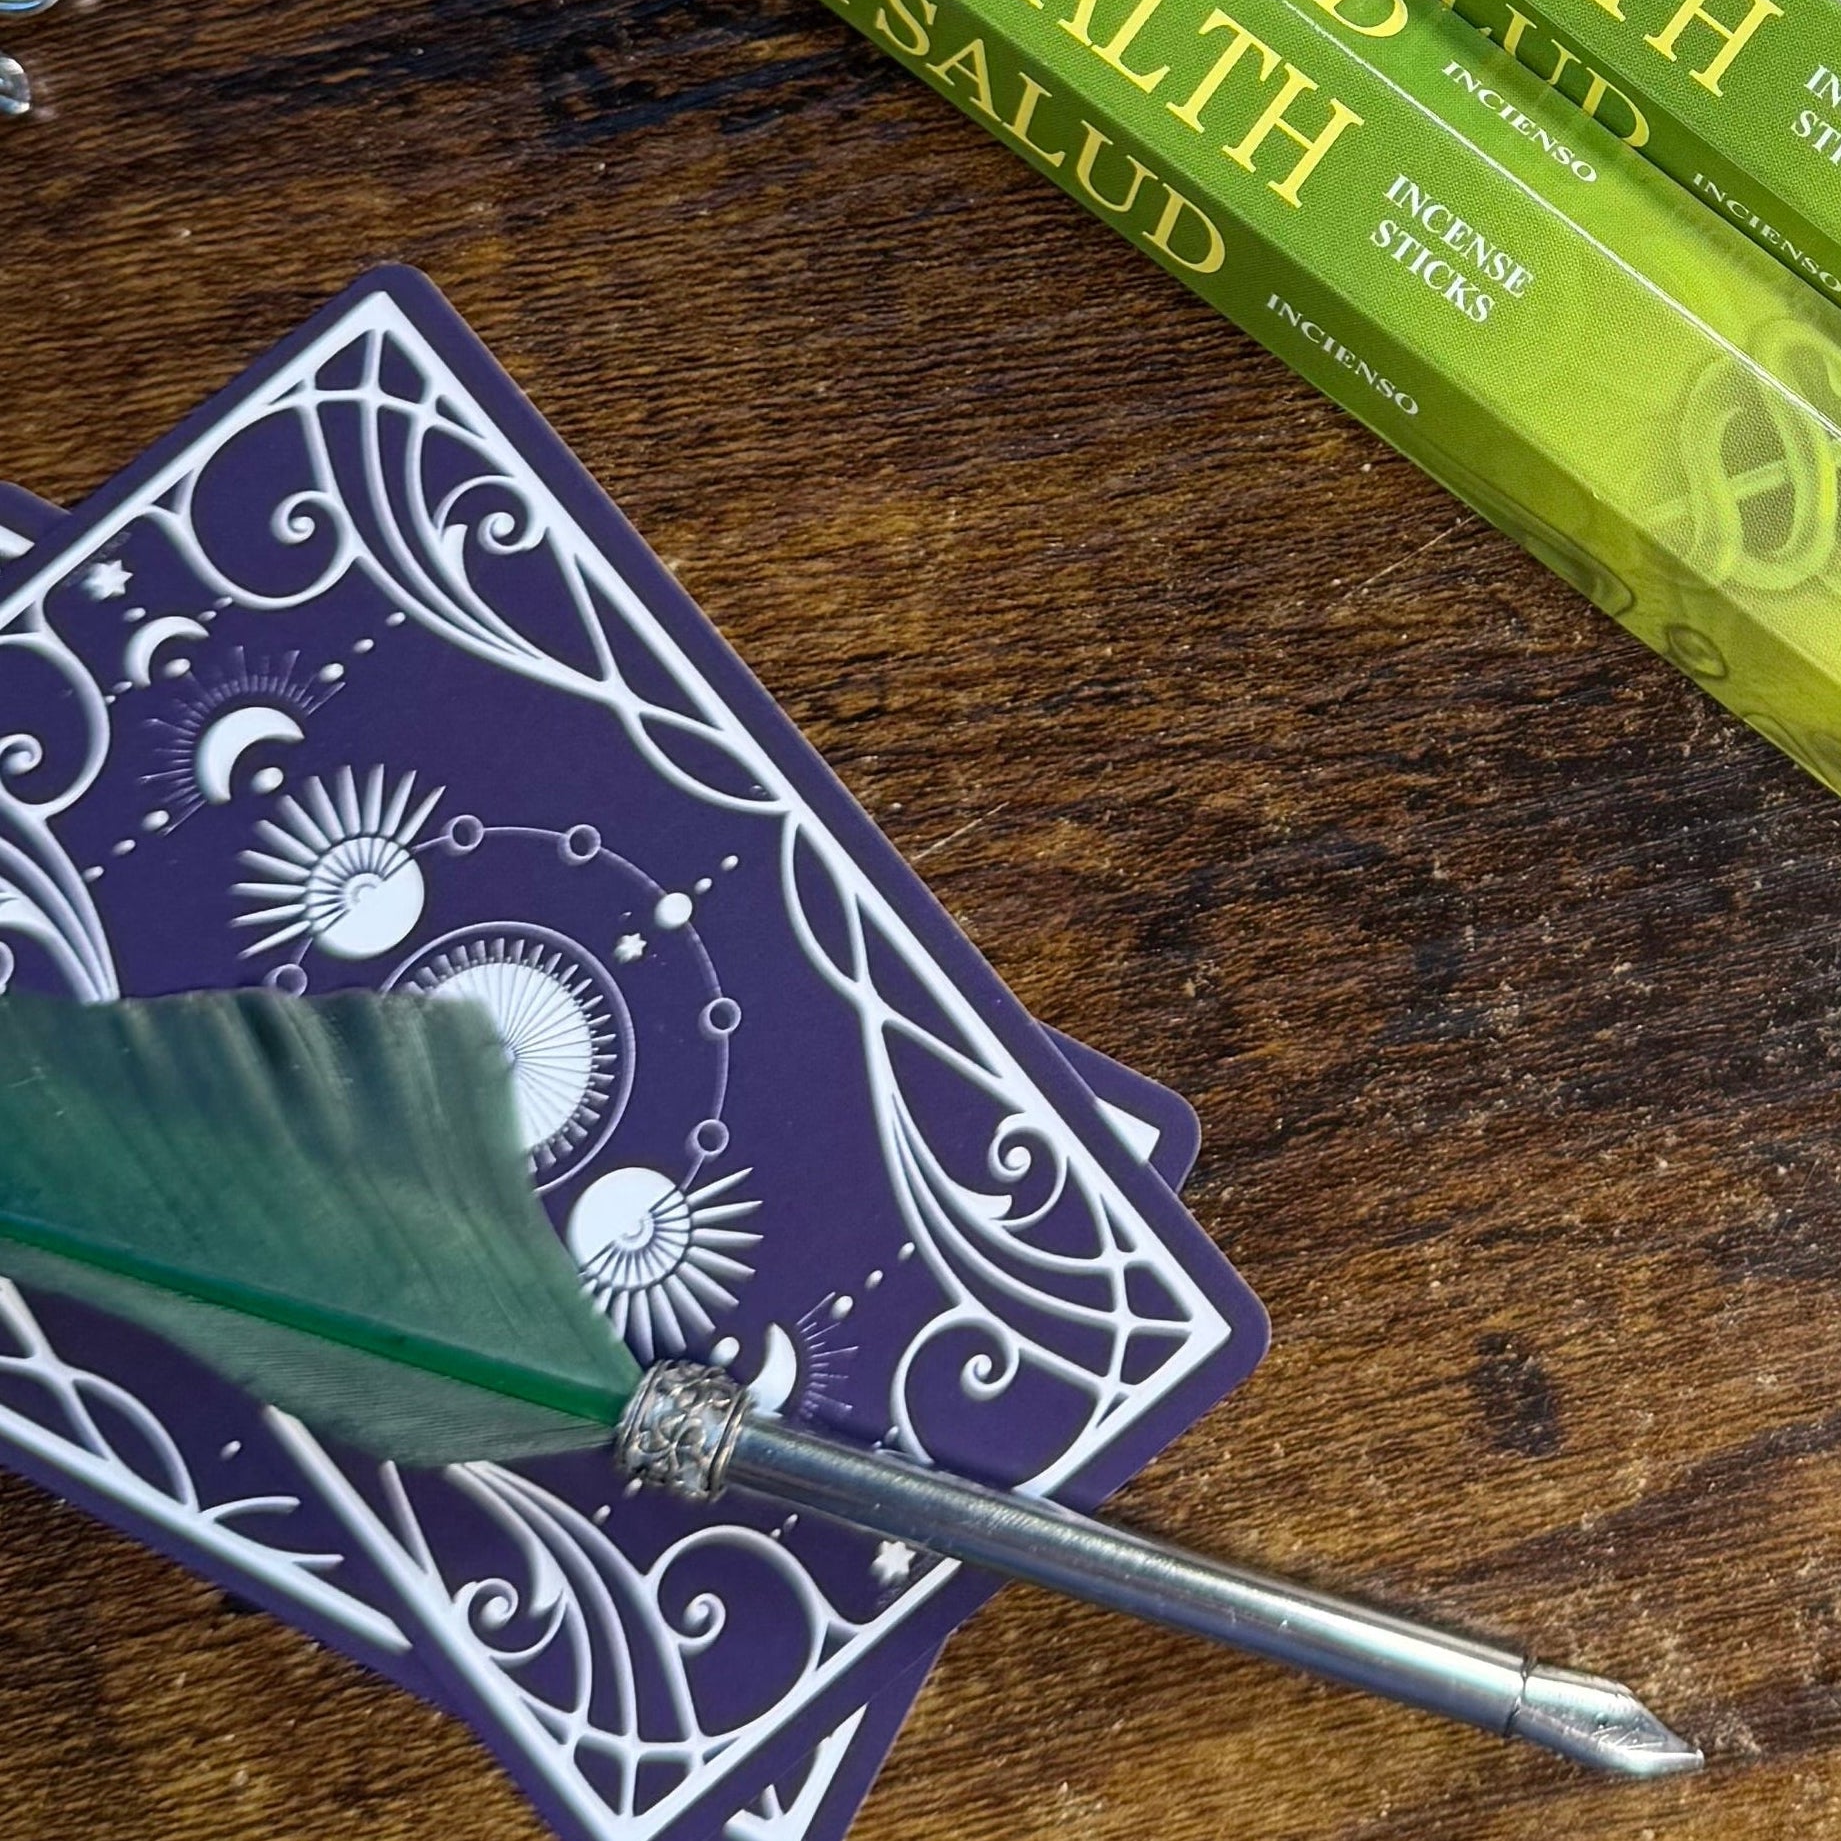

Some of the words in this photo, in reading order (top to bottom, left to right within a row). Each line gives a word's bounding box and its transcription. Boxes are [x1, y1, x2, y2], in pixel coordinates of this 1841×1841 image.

[1442, 61, 1597, 183] INCIENSO
[1368, 218, 1496, 325] STICKS
[1384, 173, 1535, 298] INCENSE
[1266, 292, 1420, 417] INCIENSO
